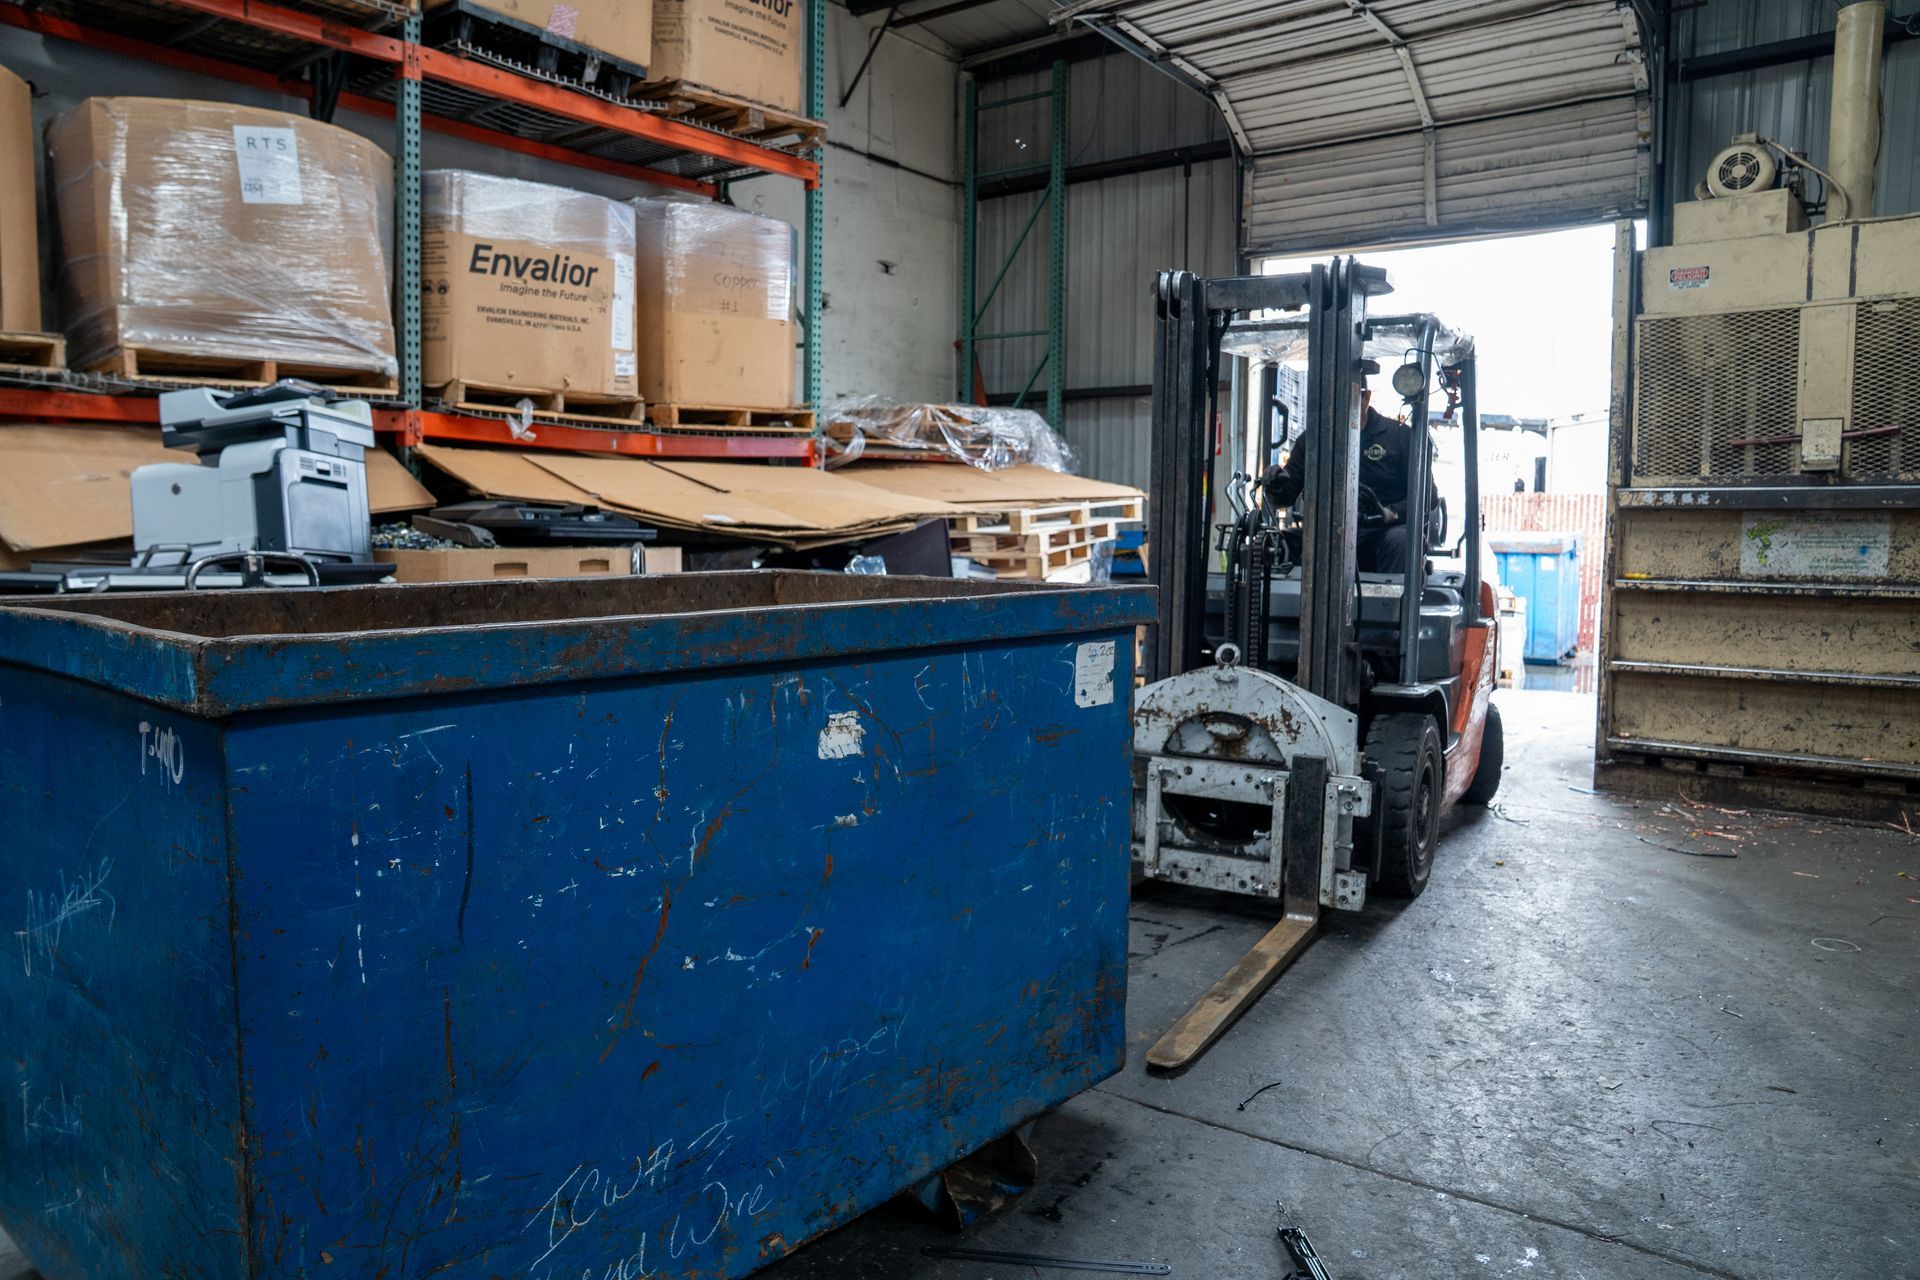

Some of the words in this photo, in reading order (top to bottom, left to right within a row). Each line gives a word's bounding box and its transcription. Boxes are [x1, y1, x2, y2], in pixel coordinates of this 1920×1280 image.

[469, 243, 599, 288] Envalior
[500, 282, 539, 297] Imagine
[541, 288, 558, 299] the
[559, 290, 588, 303] Future
[508, 308, 548, 320] ENGINEERING
[720, 299, 738, 313] #1
